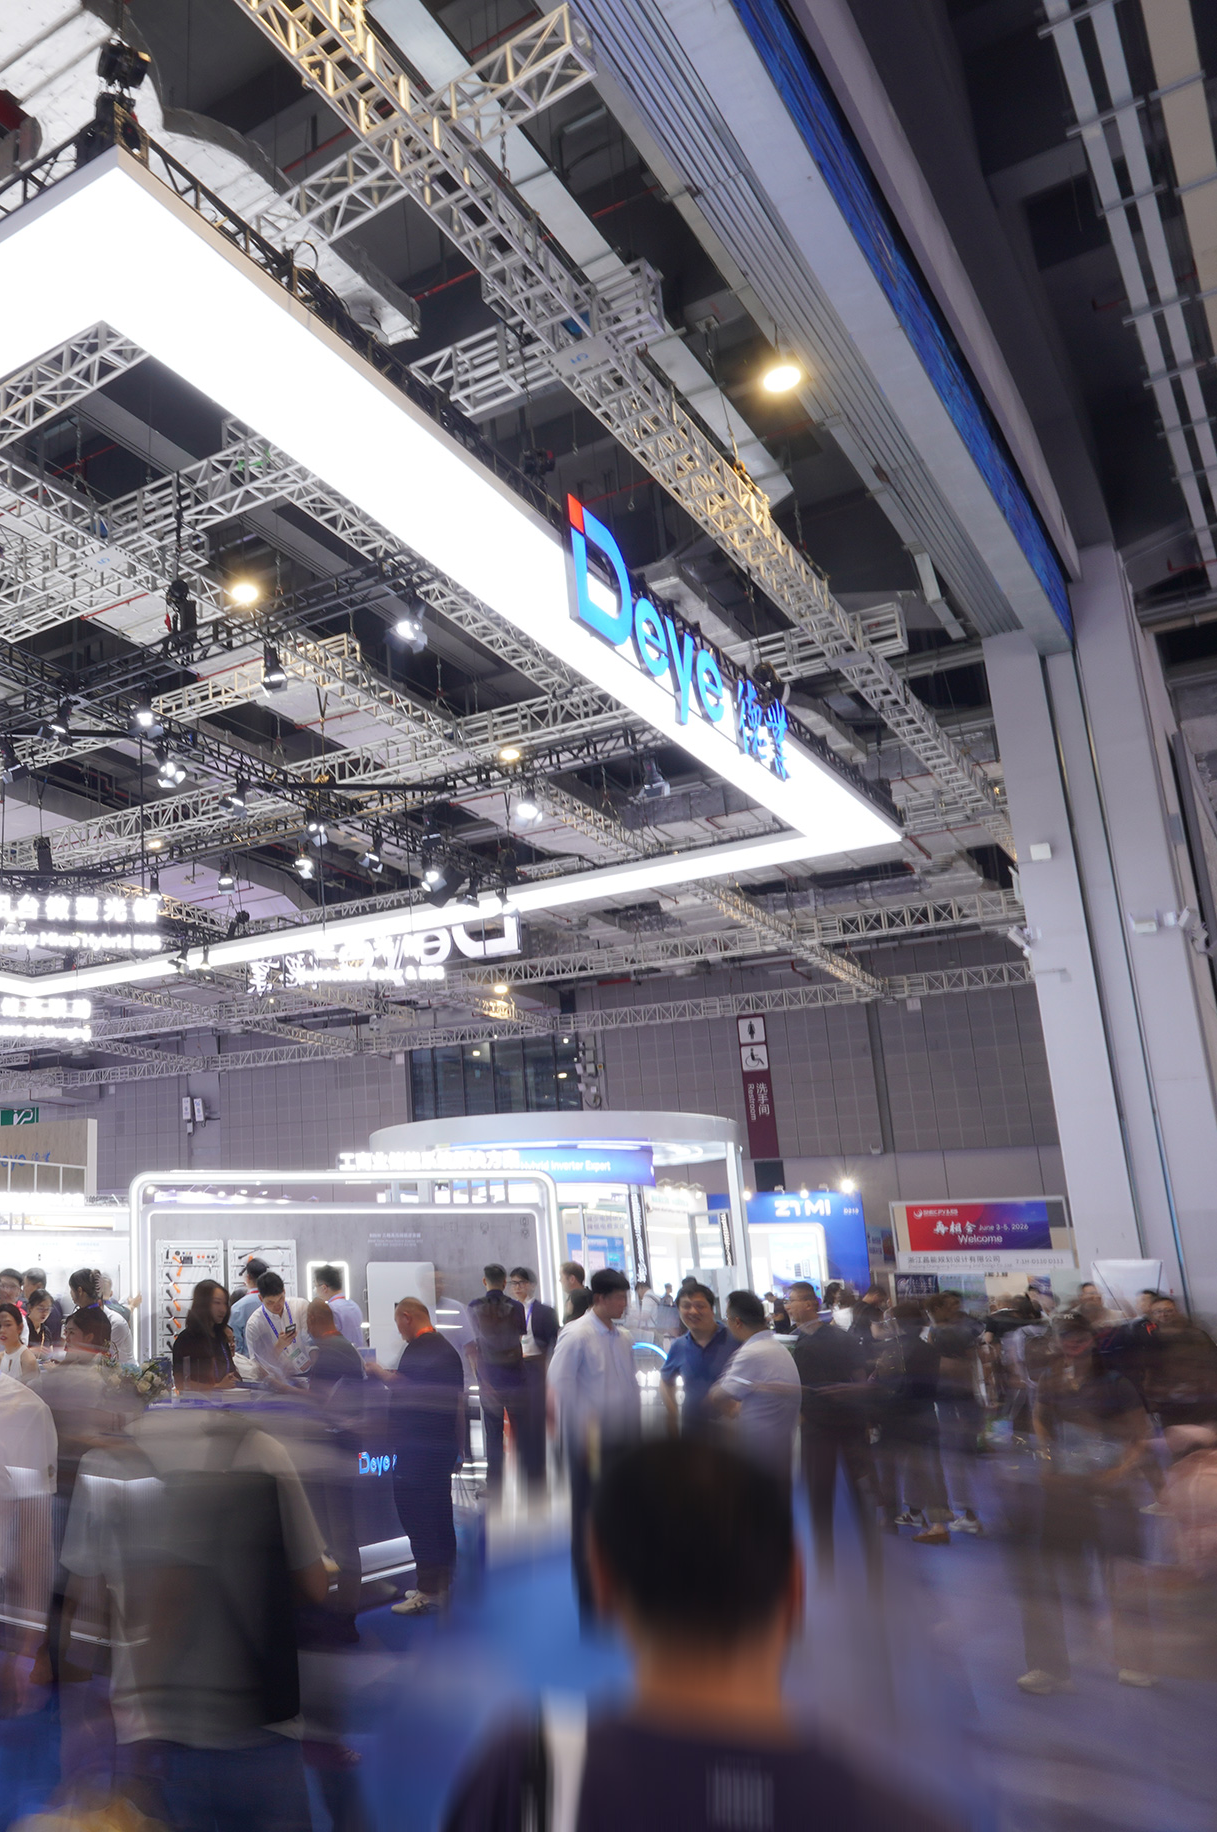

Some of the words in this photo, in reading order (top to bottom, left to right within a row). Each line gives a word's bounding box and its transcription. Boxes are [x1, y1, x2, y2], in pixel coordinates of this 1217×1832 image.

[567, 493, 725, 726] Deye
[40, 930, 81, 948] Micro
[82, 932, 132, 952] Hybrid
[748, 1083, 757, 1121] Restroom
[756, 1081, 770, 1117] 洗手间
[551, 1160, 583, 1171] Inverter
[585, 1160, 611, 1173] Expert
[958, 1234, 1003, 1244] Welcome
[979, 1223, 995, 1232] June
[1011, 1223, 1029, 1231] 2026
[358, 1451, 390, 1477] Deye
